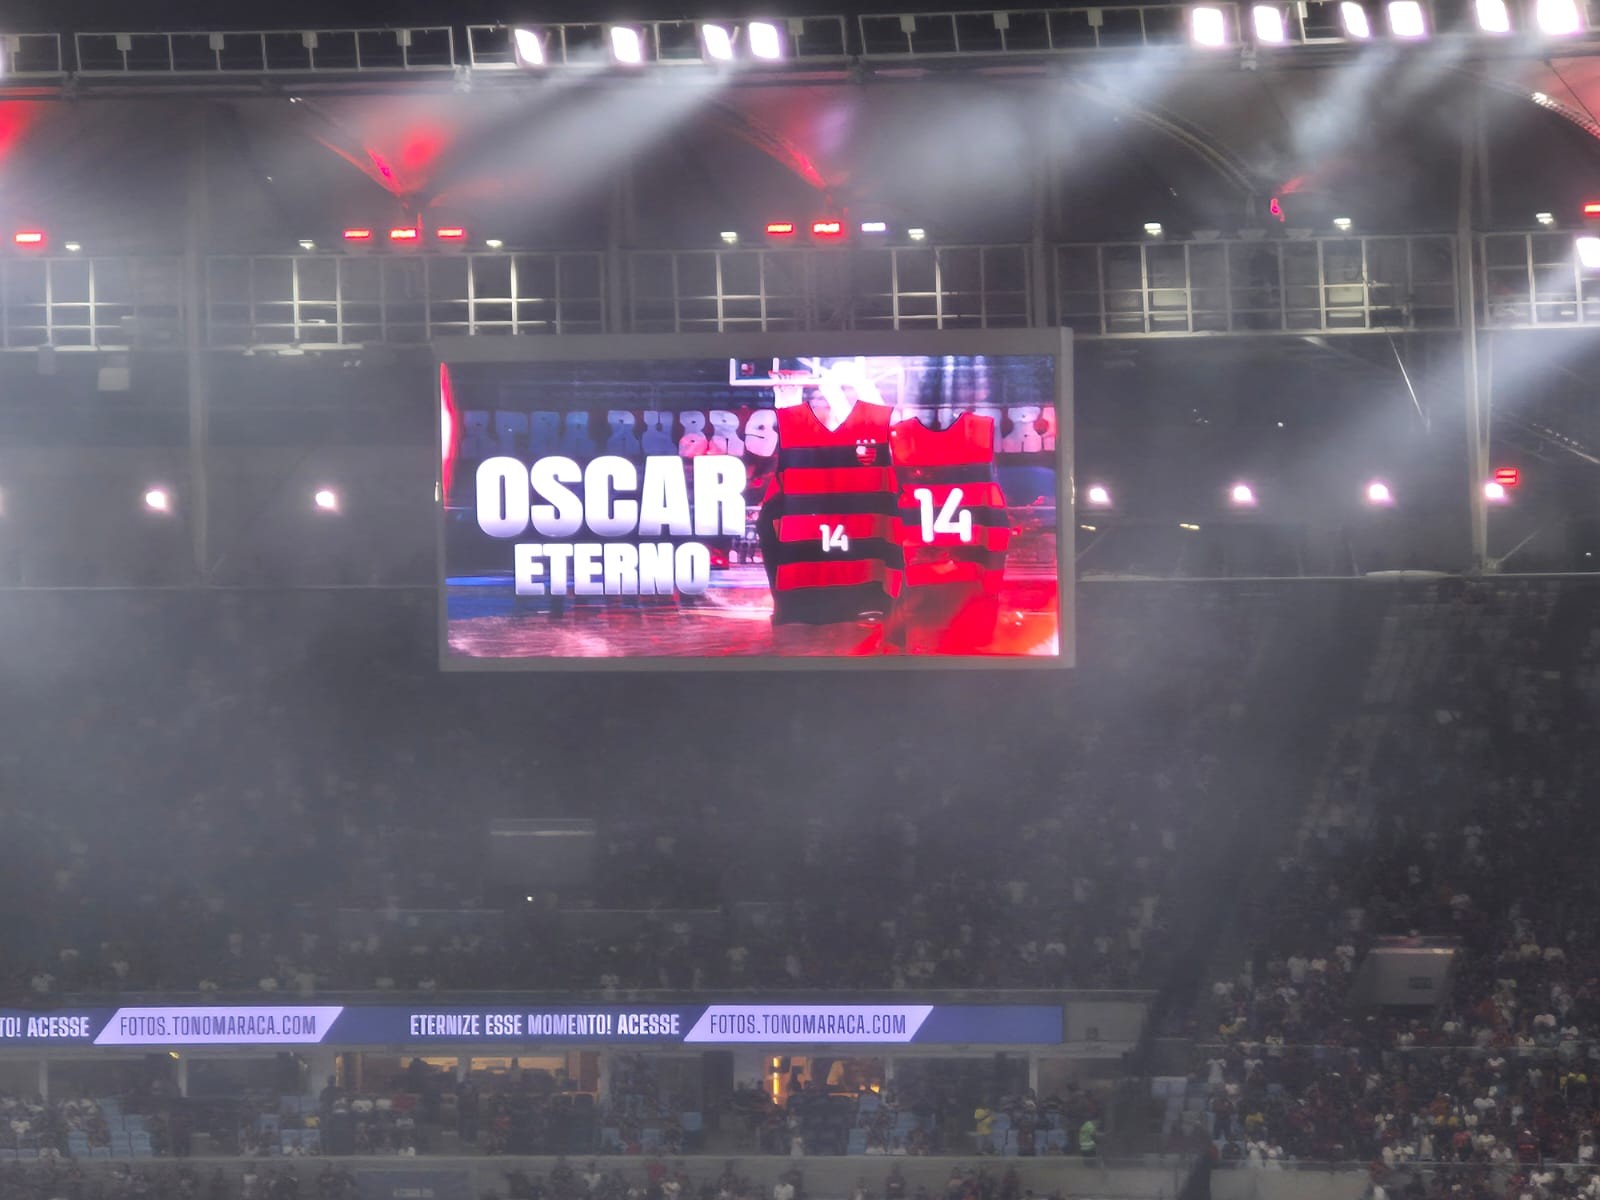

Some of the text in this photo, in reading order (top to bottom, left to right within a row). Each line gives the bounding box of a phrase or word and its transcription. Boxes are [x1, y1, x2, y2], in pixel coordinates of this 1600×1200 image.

[476, 455, 747, 538] OSCAR
[914, 487, 972, 543] 14
[819, 524, 849, 552] 14
[514, 541, 711, 595] ETERNO
[27, 1016, 90, 1037] ACESSE
[120, 1015, 316, 1036] FOTOS.TONOMARACA.COM
[410, 1013, 680, 1035] ETERNIZE ESSE MOMENTO! ACESSE
[710, 1014, 906, 1034] FOTOS.TONOMARACA.COM
